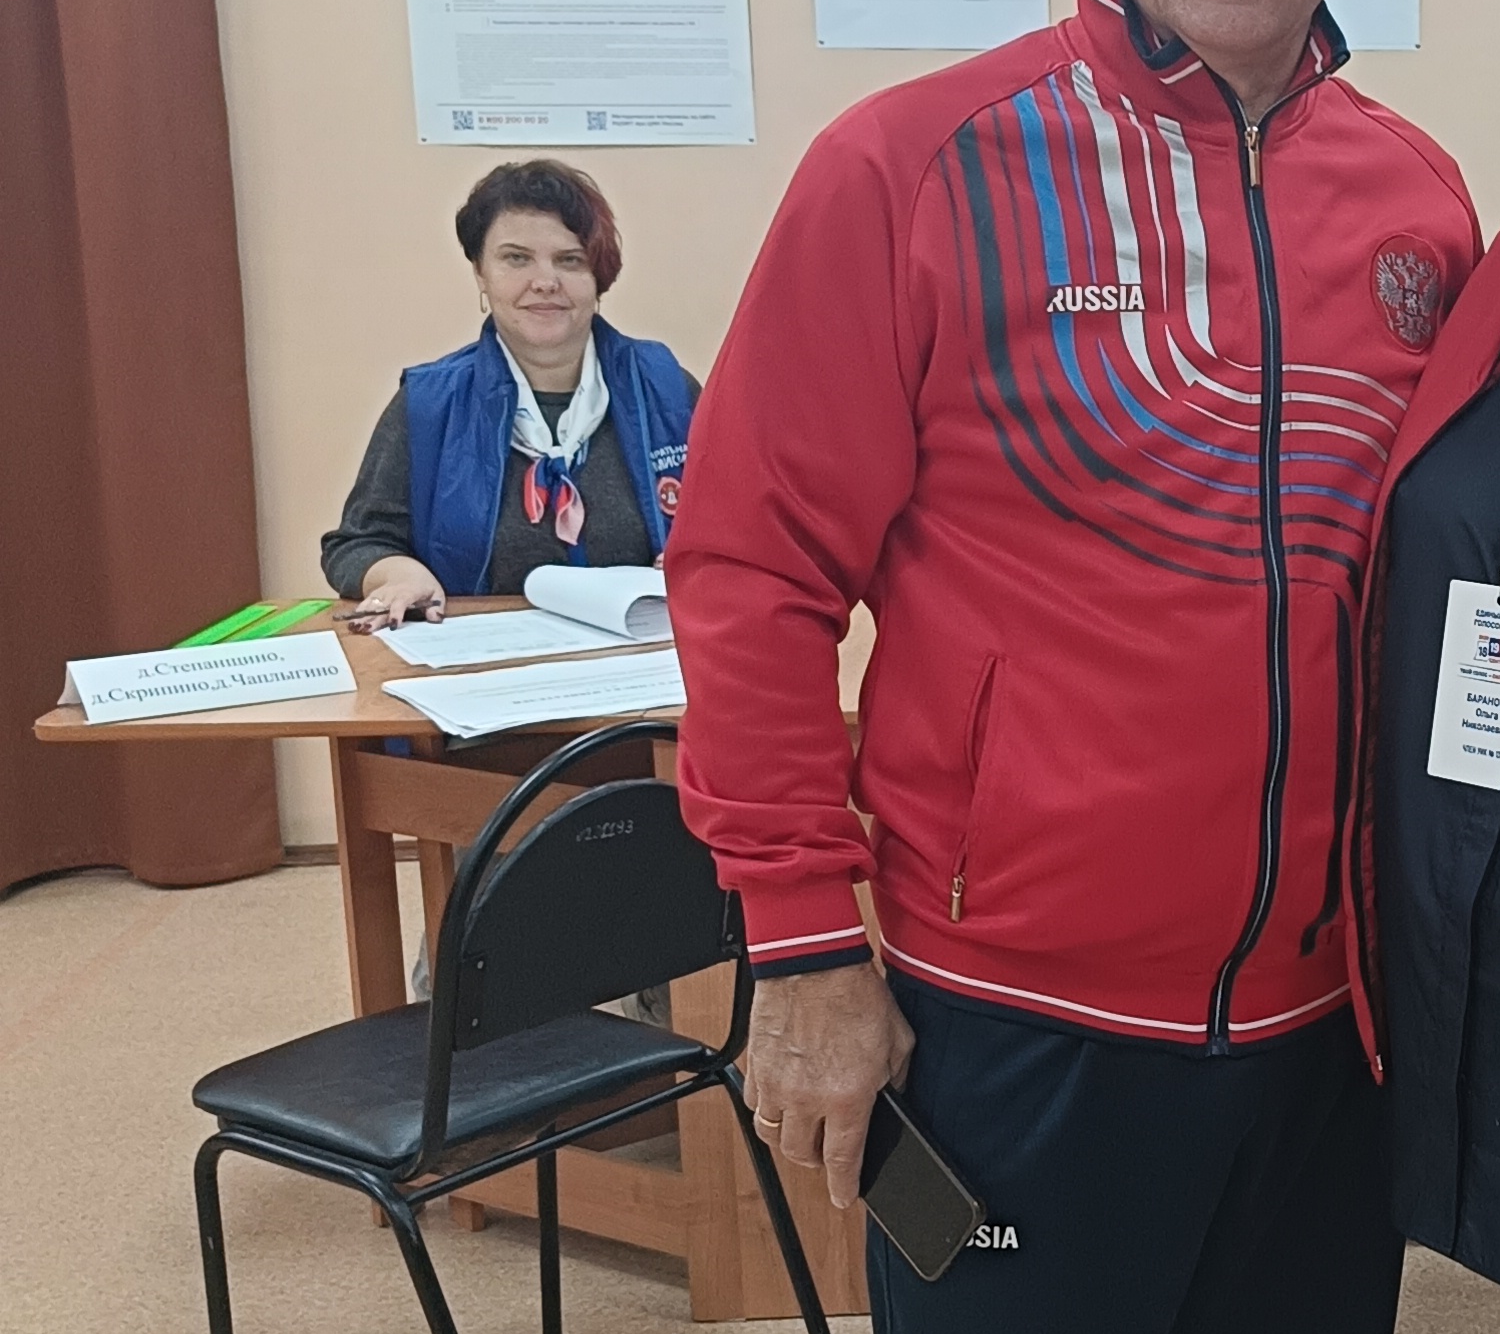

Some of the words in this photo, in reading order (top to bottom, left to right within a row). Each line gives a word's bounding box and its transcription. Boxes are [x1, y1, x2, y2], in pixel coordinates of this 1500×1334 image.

[1046, 285, 1146, 313] RUSSIA
[1475, 708, 1499, 721] Ольга
[966, 1225, 1019, 1249] SIA
